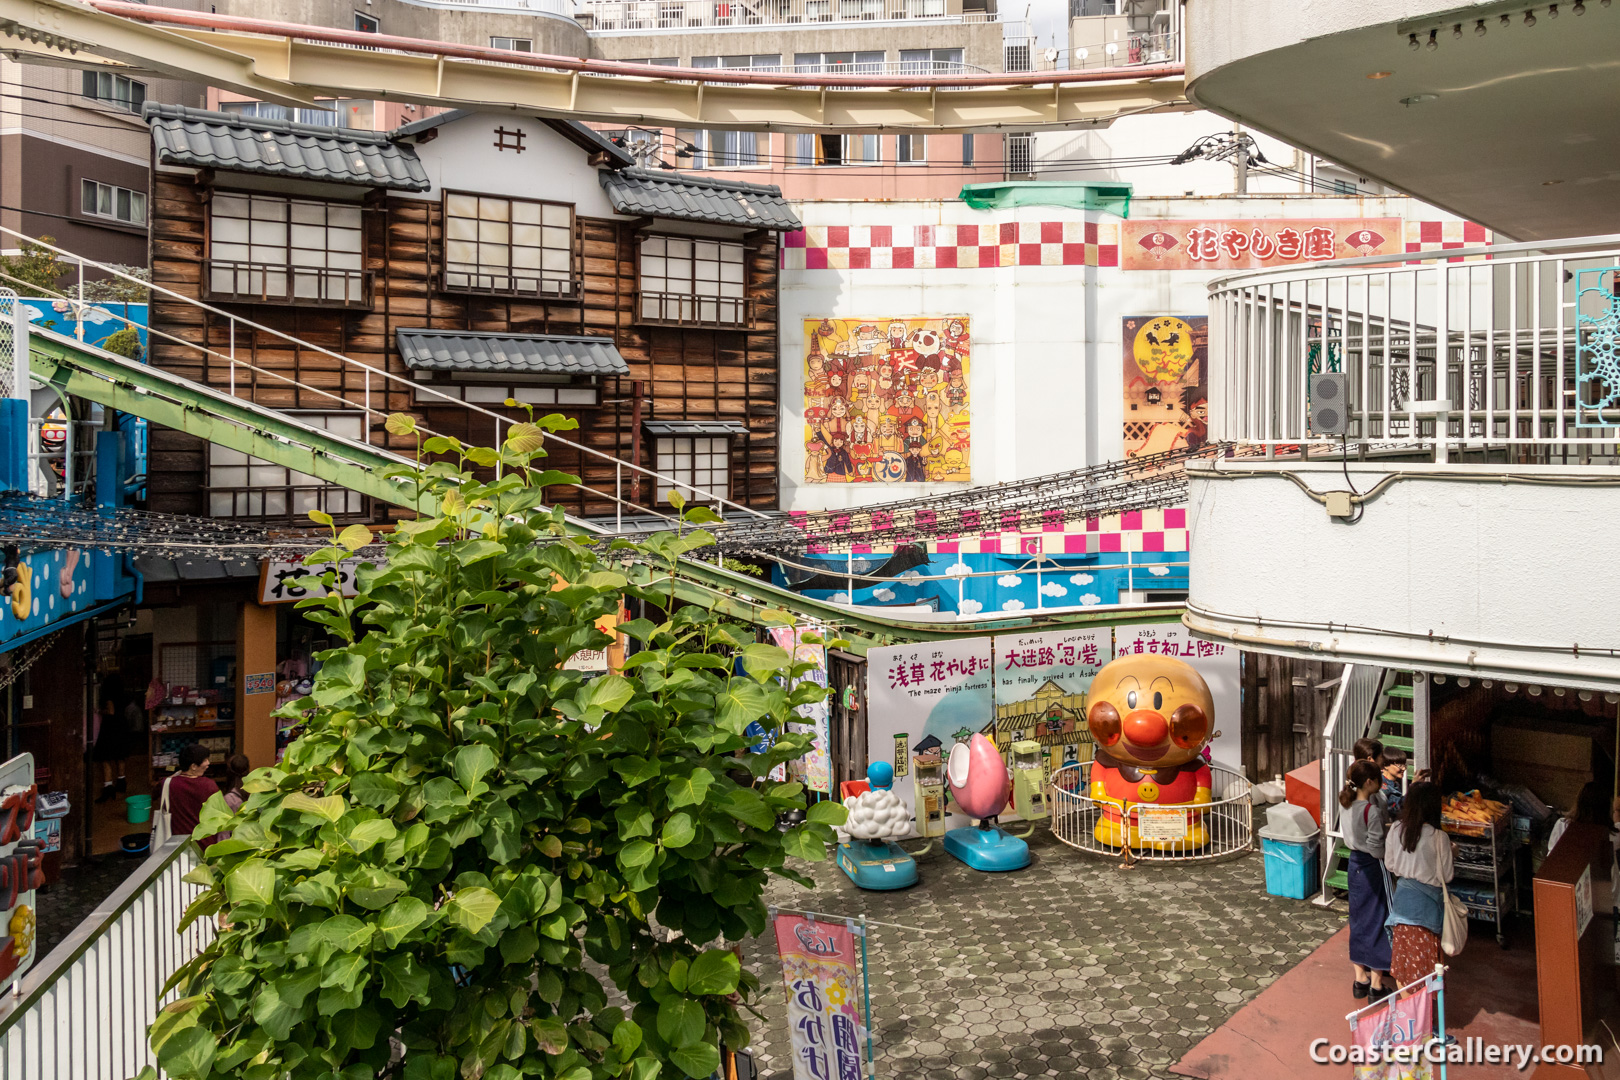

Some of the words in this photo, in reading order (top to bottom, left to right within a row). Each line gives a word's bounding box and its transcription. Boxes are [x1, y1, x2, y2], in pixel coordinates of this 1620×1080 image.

[1186, 226, 1336, 261] 花やしき座
[893, 351, 919, 371] 笑
[271, 566, 358, 598] 花や
[1002, 678, 1013, 686] has
[1018, 674, 1038, 684] finally
[1043, 672, 1064, 681] arrived
[1069, 671, 1075, 679] at
[908, 689, 921, 697] The
